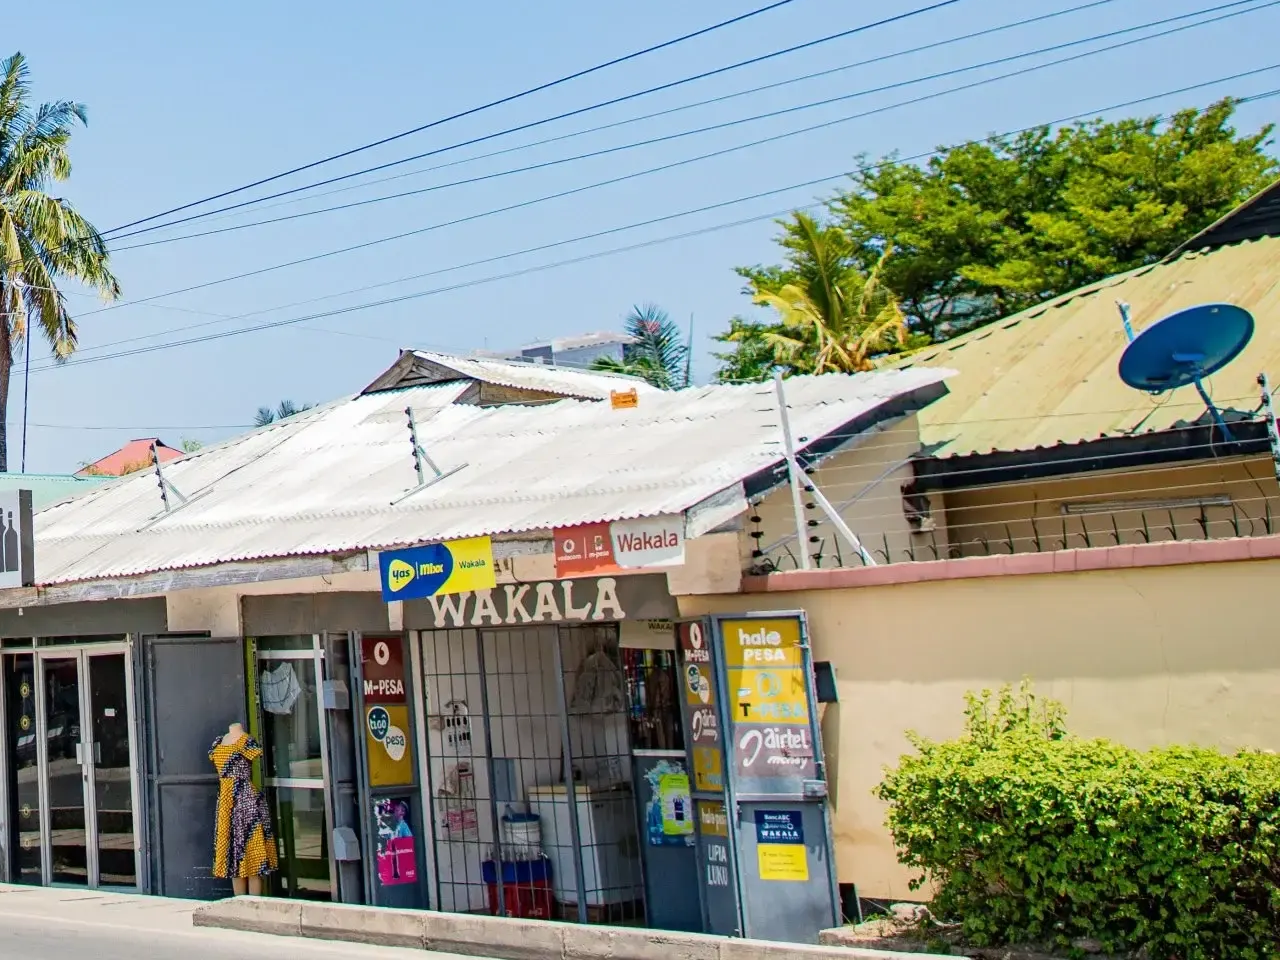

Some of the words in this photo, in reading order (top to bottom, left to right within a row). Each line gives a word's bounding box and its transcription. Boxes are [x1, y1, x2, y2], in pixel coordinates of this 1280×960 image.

[617, 529, 678, 552] Wakala
[459, 559, 485, 569] Wakala
[392, 569, 410, 581] yas
[426, 577, 626, 628] WAKALA
[738, 628, 781, 646] halo
[744, 648, 786, 661] PESA
[364, 679, 404, 695] M-PESA
[739, 703, 806, 718] T-PESA
[386, 735, 404, 748] pesa
[763, 728, 810, 749] airtel
